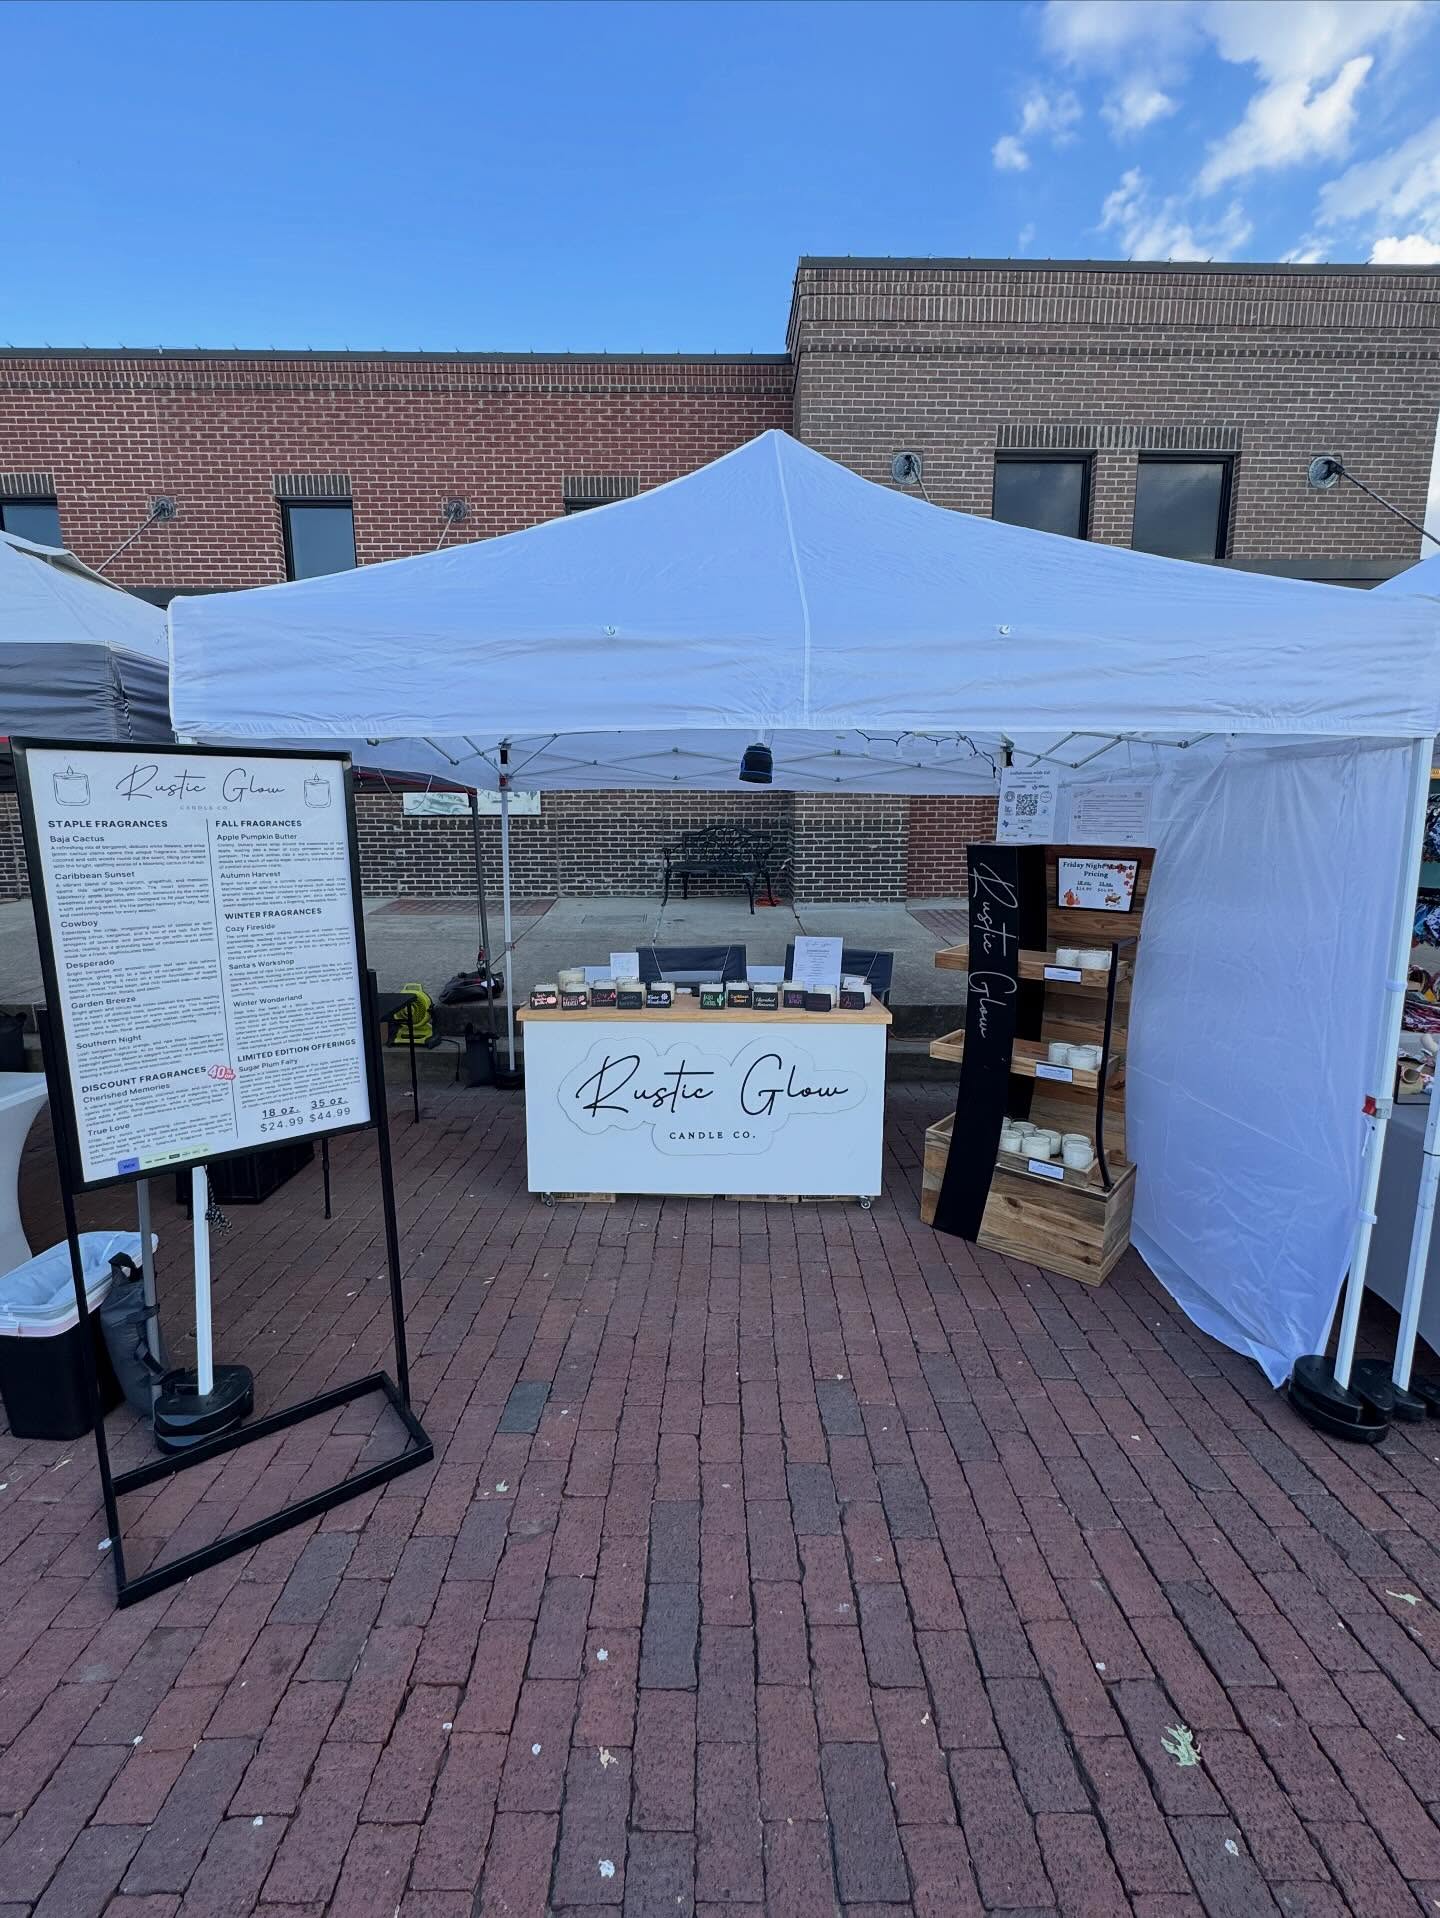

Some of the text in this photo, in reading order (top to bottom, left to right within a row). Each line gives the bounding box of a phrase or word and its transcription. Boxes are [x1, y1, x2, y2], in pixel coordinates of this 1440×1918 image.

[116, 764, 286, 802] Rustic Glow
[48, 820, 168, 828] STAPLE FRAGRANCES
[50, 834, 105, 844] Baja Cactus
[241, 833, 273, 841] Pumpkin
[1062, 861, 1085, 870] Friday
[1085, 862, 1106, 871] Night
[55, 871, 135, 880] Caribbean Sunset
[1083, 870, 1108, 879] Pricing
[225, 907, 323, 920] WINTER FRAGRANCES
[60, 919, 98, 928] Cowboy
[225, 923, 276, 933] Cozy Fireside
[968, 862, 1019, 1038] Rustic Glow
[66, 959, 115, 970] Desperado
[258, 959, 295, 968] Workshop
[71, 996, 136, 1009] Garden Breeze
[260, 994, 303, 1004] Wonderland
[76, 1034, 142, 1050] Southern Night
[237, 1039, 357, 1062] LIMITED EDITION OFFERINGS
[238, 1058, 298, 1073] Sugar Plum Fairy
[81, 1066, 207, 1093] DISCOUNT FRAGRANCES
[575, 1053, 849, 1117] Rustic Glow
[83, 1083, 171, 1104] Cherished Memories
[311, 1099, 325, 1109] 35
[262, 1108, 276, 1118] 18
[309, 1107, 351, 1123] $44.99
[88, 1123, 130, 1136] True Love
[260, 1116, 304, 1133] $24.99
[669, 1130, 756, 1140] CANDLE CO.
